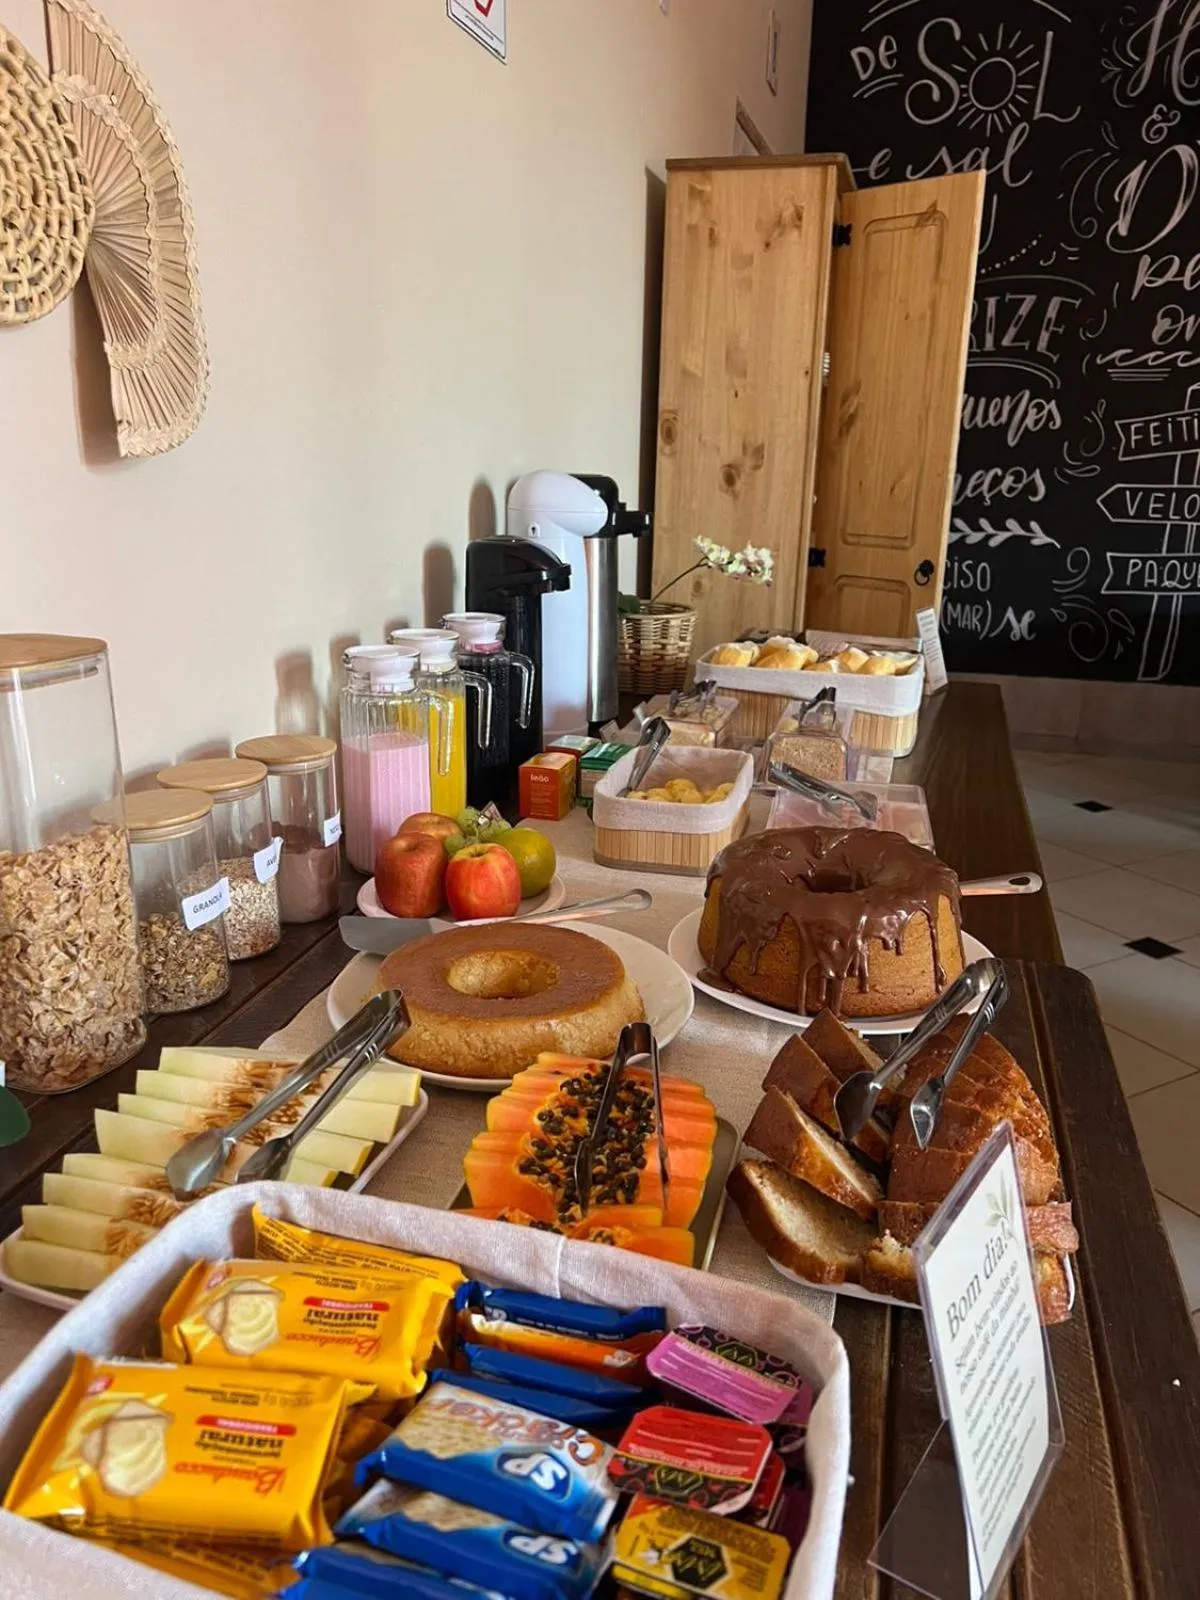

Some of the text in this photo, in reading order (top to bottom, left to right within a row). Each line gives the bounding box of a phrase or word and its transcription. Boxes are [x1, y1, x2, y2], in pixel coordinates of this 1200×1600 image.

[1141, 103, 1181, 144] &
[1126, 490, 1200, 520] VELO
[1126, 559, 1200, 590] PAQU
[988, 606, 1036, 641] se
[946, 1274, 982, 1342] Bom
[983, 1221, 1009, 1280] dia!
[307, 1309, 379, 1322] natural
[200, 1430, 284, 1448] natural
[503, 1453, 570, 1491] SP
[509, 1535, 579, 1565] SP
